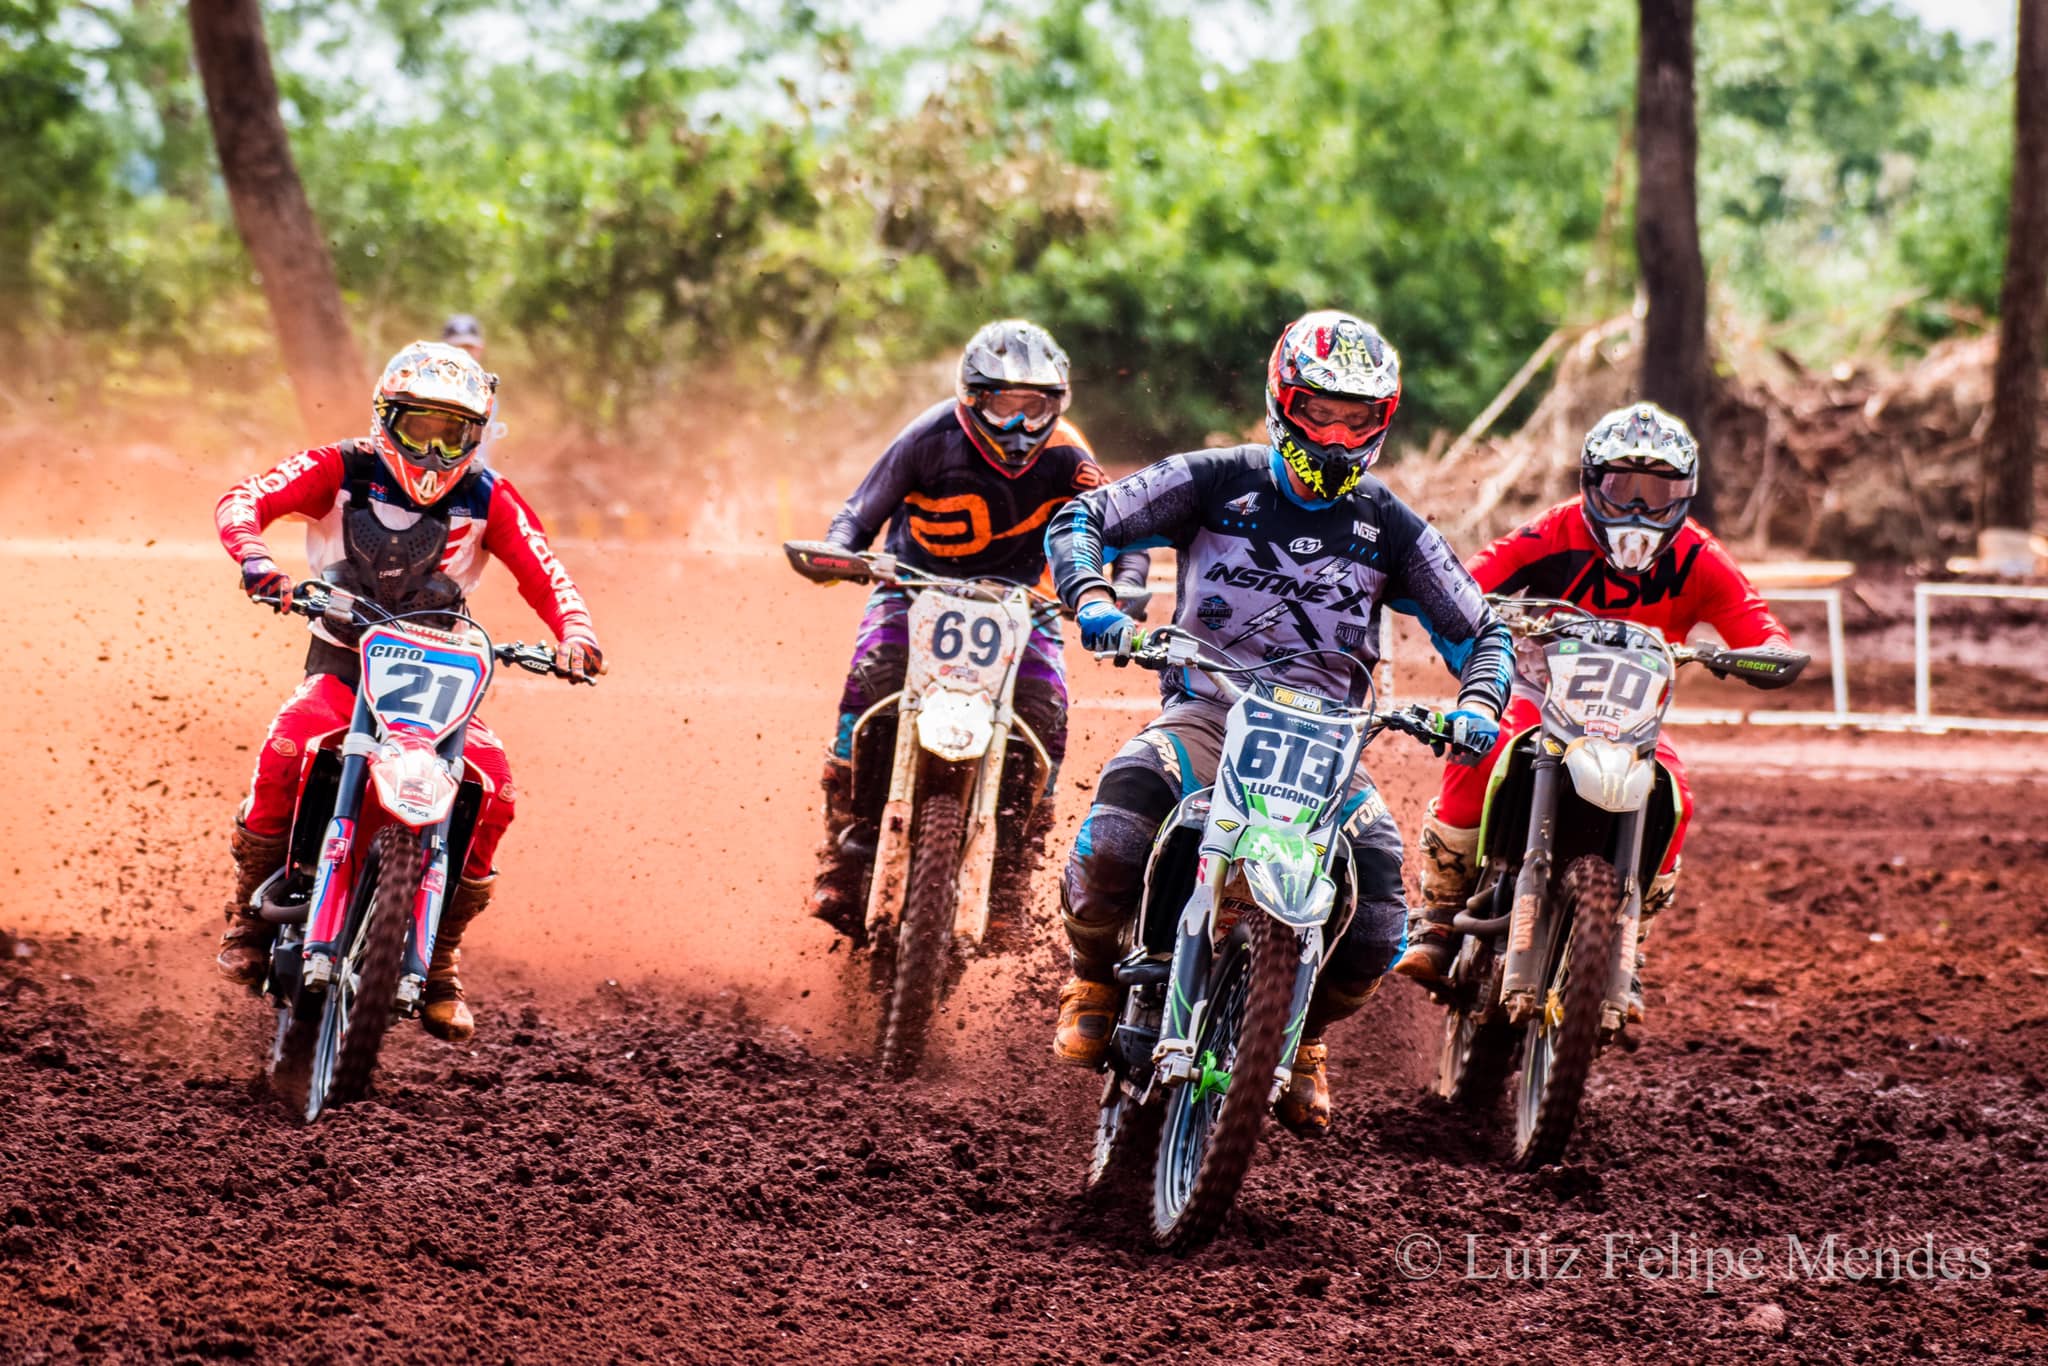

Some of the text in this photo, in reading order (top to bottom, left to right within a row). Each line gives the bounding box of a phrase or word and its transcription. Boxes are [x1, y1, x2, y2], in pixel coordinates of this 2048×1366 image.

[1567, 544, 1703, 609] ASW
[369, 645, 423, 661] CIRO
[932, 610, 1002, 668] 69
[1567, 657, 1652, 710] 20
[1736, 659, 1777, 673] CIRCUIT
[376, 662, 464, 725] 21
[1585, 704, 1623, 721] FILE
[1236, 728, 1345, 799] 613
[1249, 782, 1320, 810] LUCIANO
